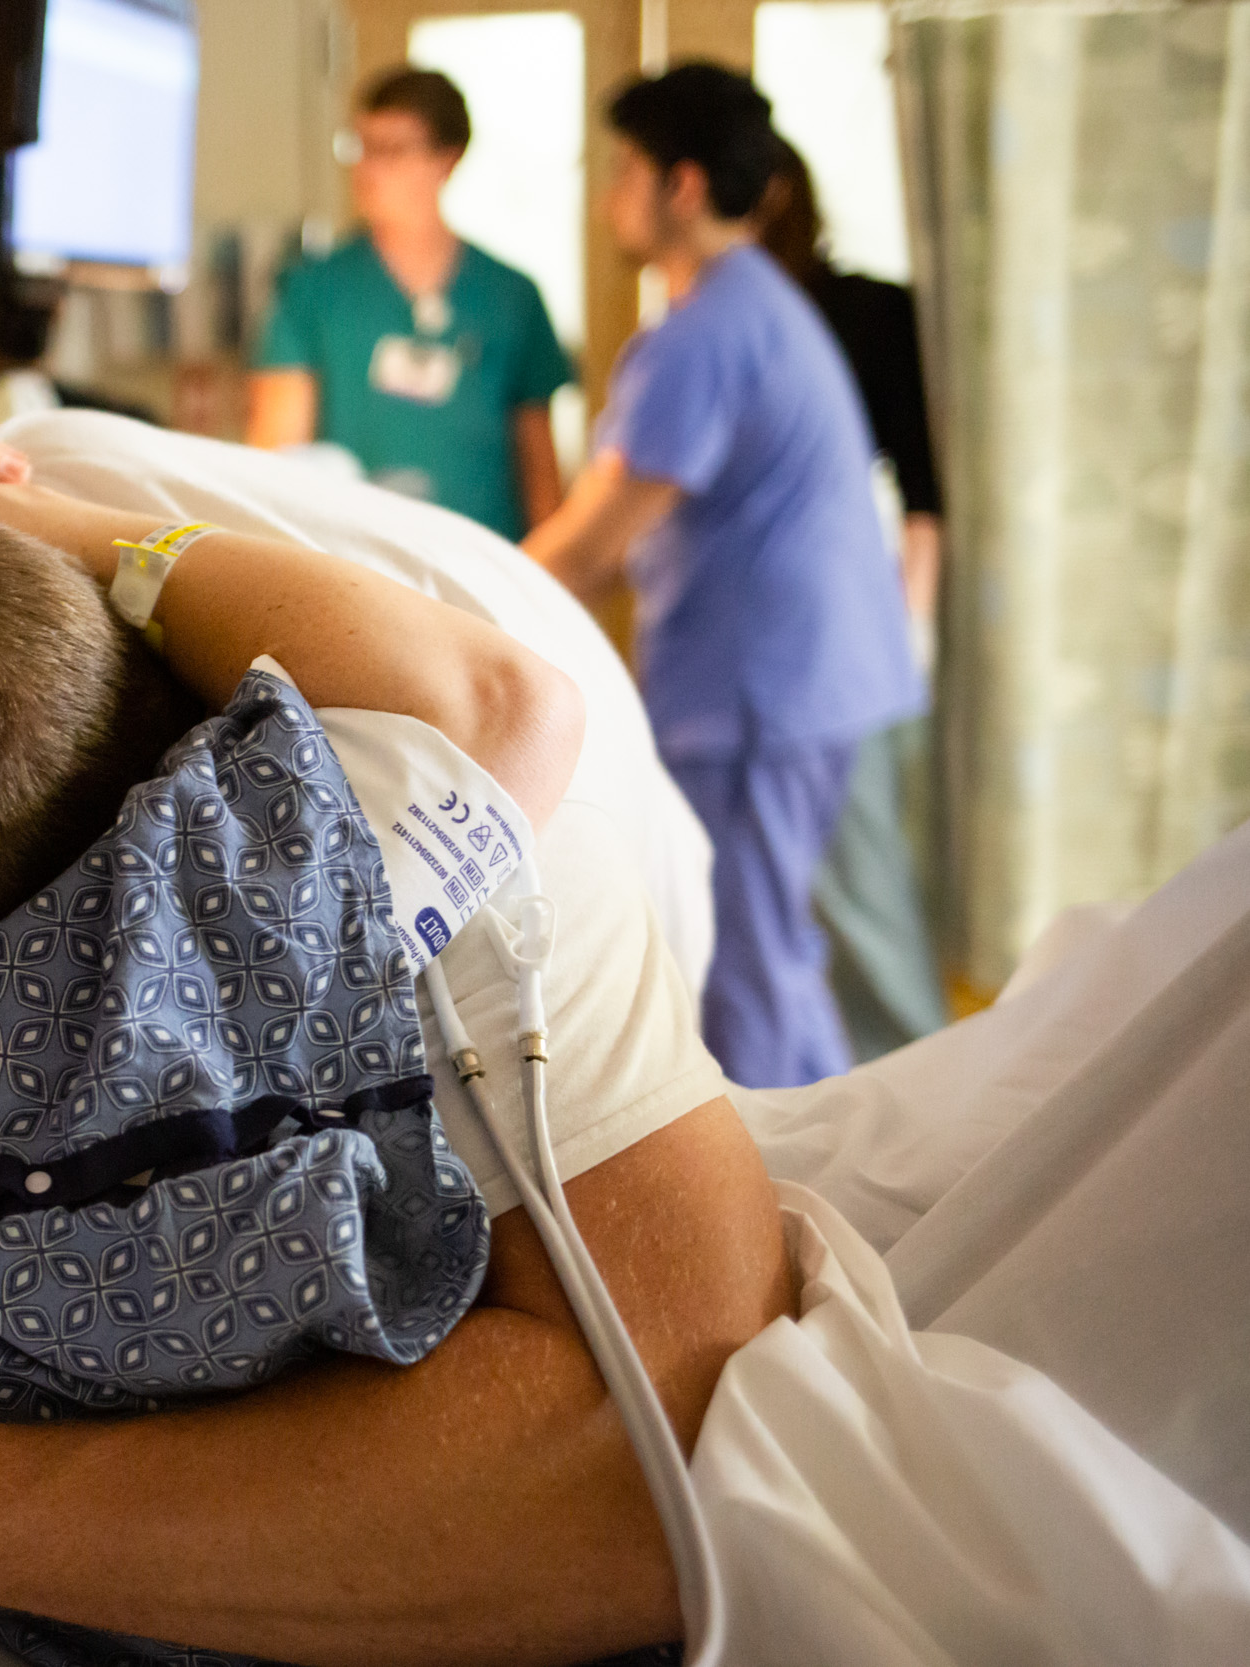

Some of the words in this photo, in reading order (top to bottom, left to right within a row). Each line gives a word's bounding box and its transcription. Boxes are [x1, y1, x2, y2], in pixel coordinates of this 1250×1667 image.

[463, 863, 482, 886] GTIN
[447, 881, 466, 904] GTIN
[395, 920, 421, 959] Pressur
[420, 916, 447, 951] ADULT
